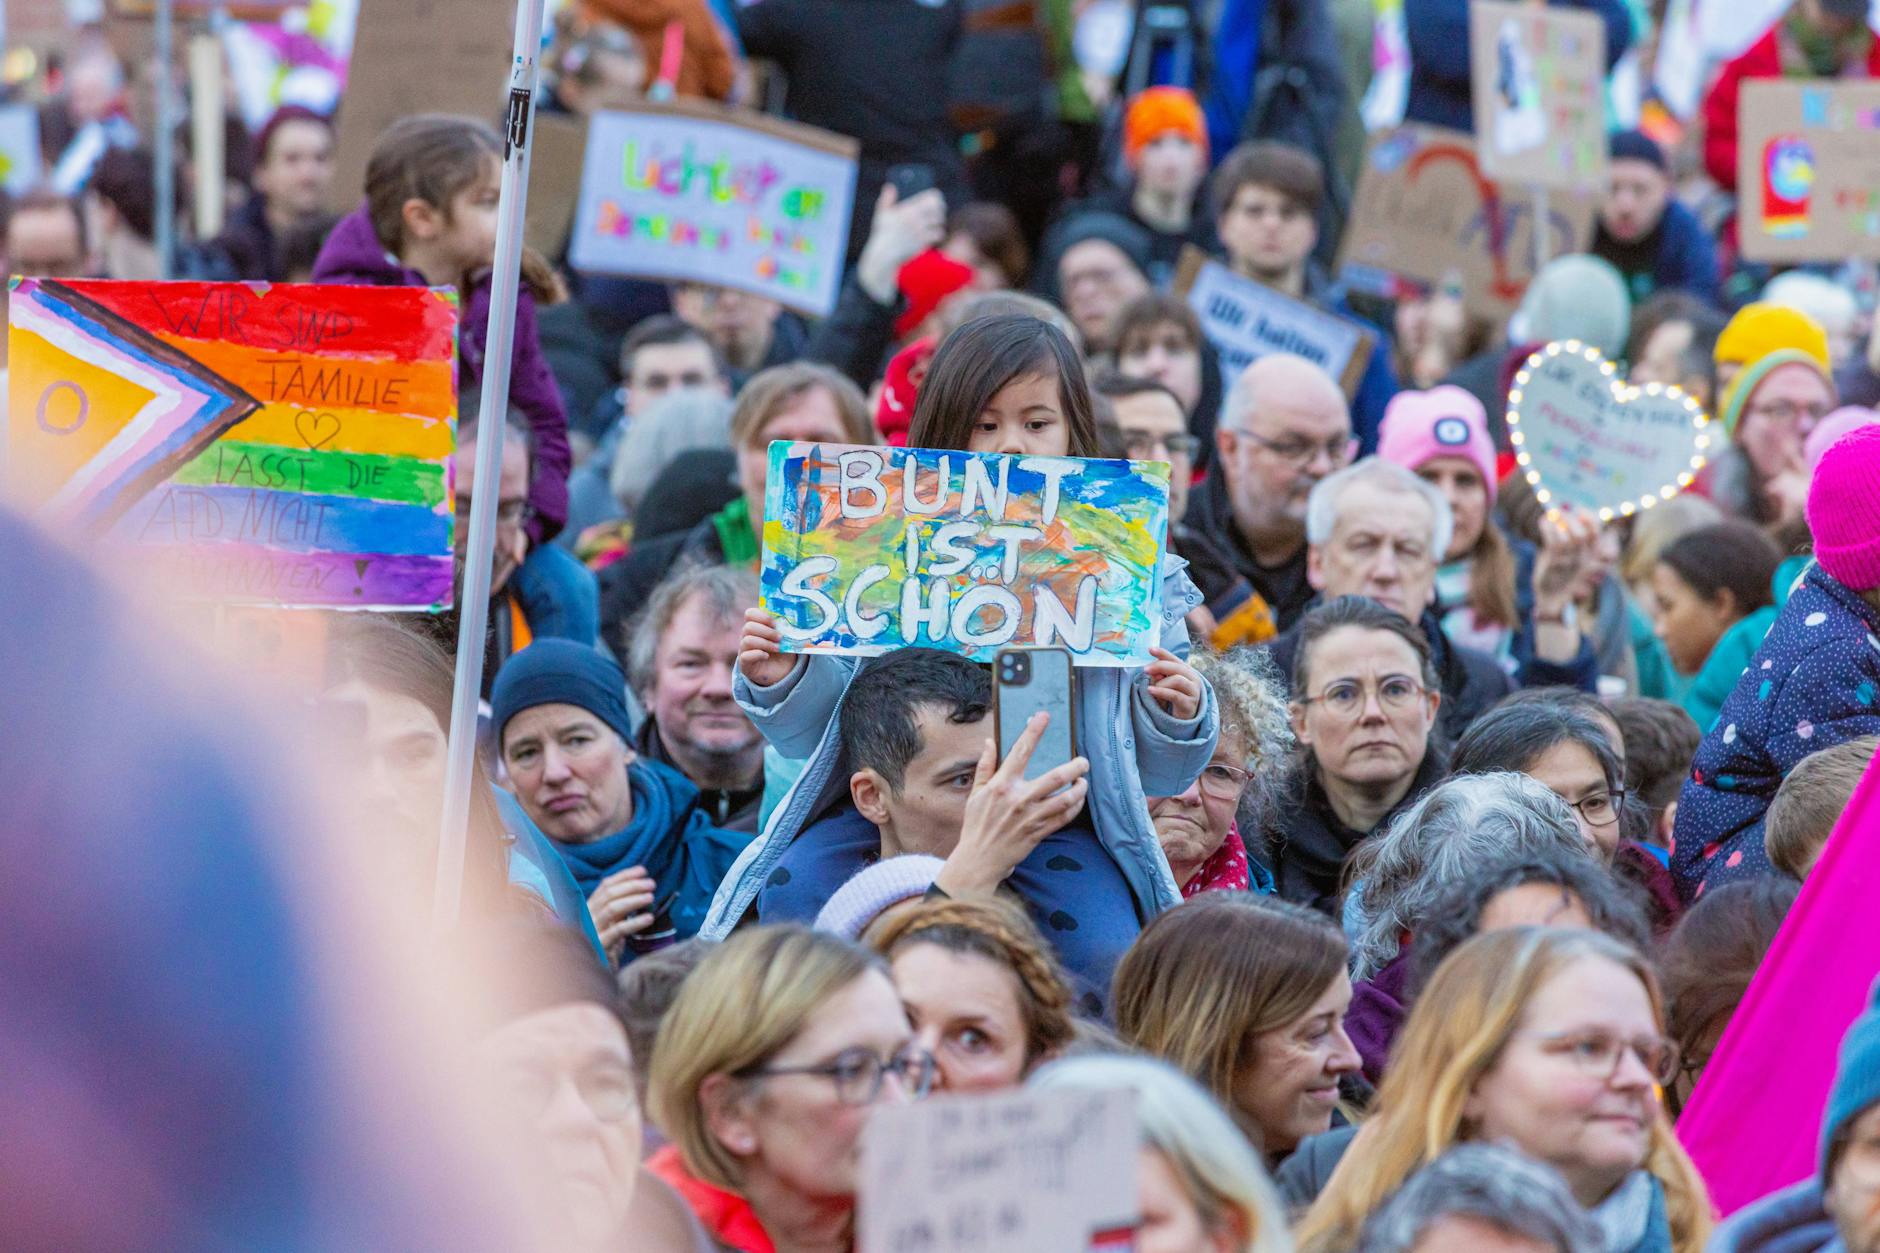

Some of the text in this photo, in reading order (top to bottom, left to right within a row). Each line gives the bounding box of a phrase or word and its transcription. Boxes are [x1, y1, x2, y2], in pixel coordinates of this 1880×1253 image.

[147, 286, 354, 347] WIR SIND
[256, 358, 409, 406] FAMILIE
[214, 447, 392, 491] LASST DIE
[837, 449, 1087, 525] BUNT
[138, 487, 335, 544] AFD NICHT
[905, 520, 1044, 584] IST
[776, 554, 1099, 654] SCHÖN
